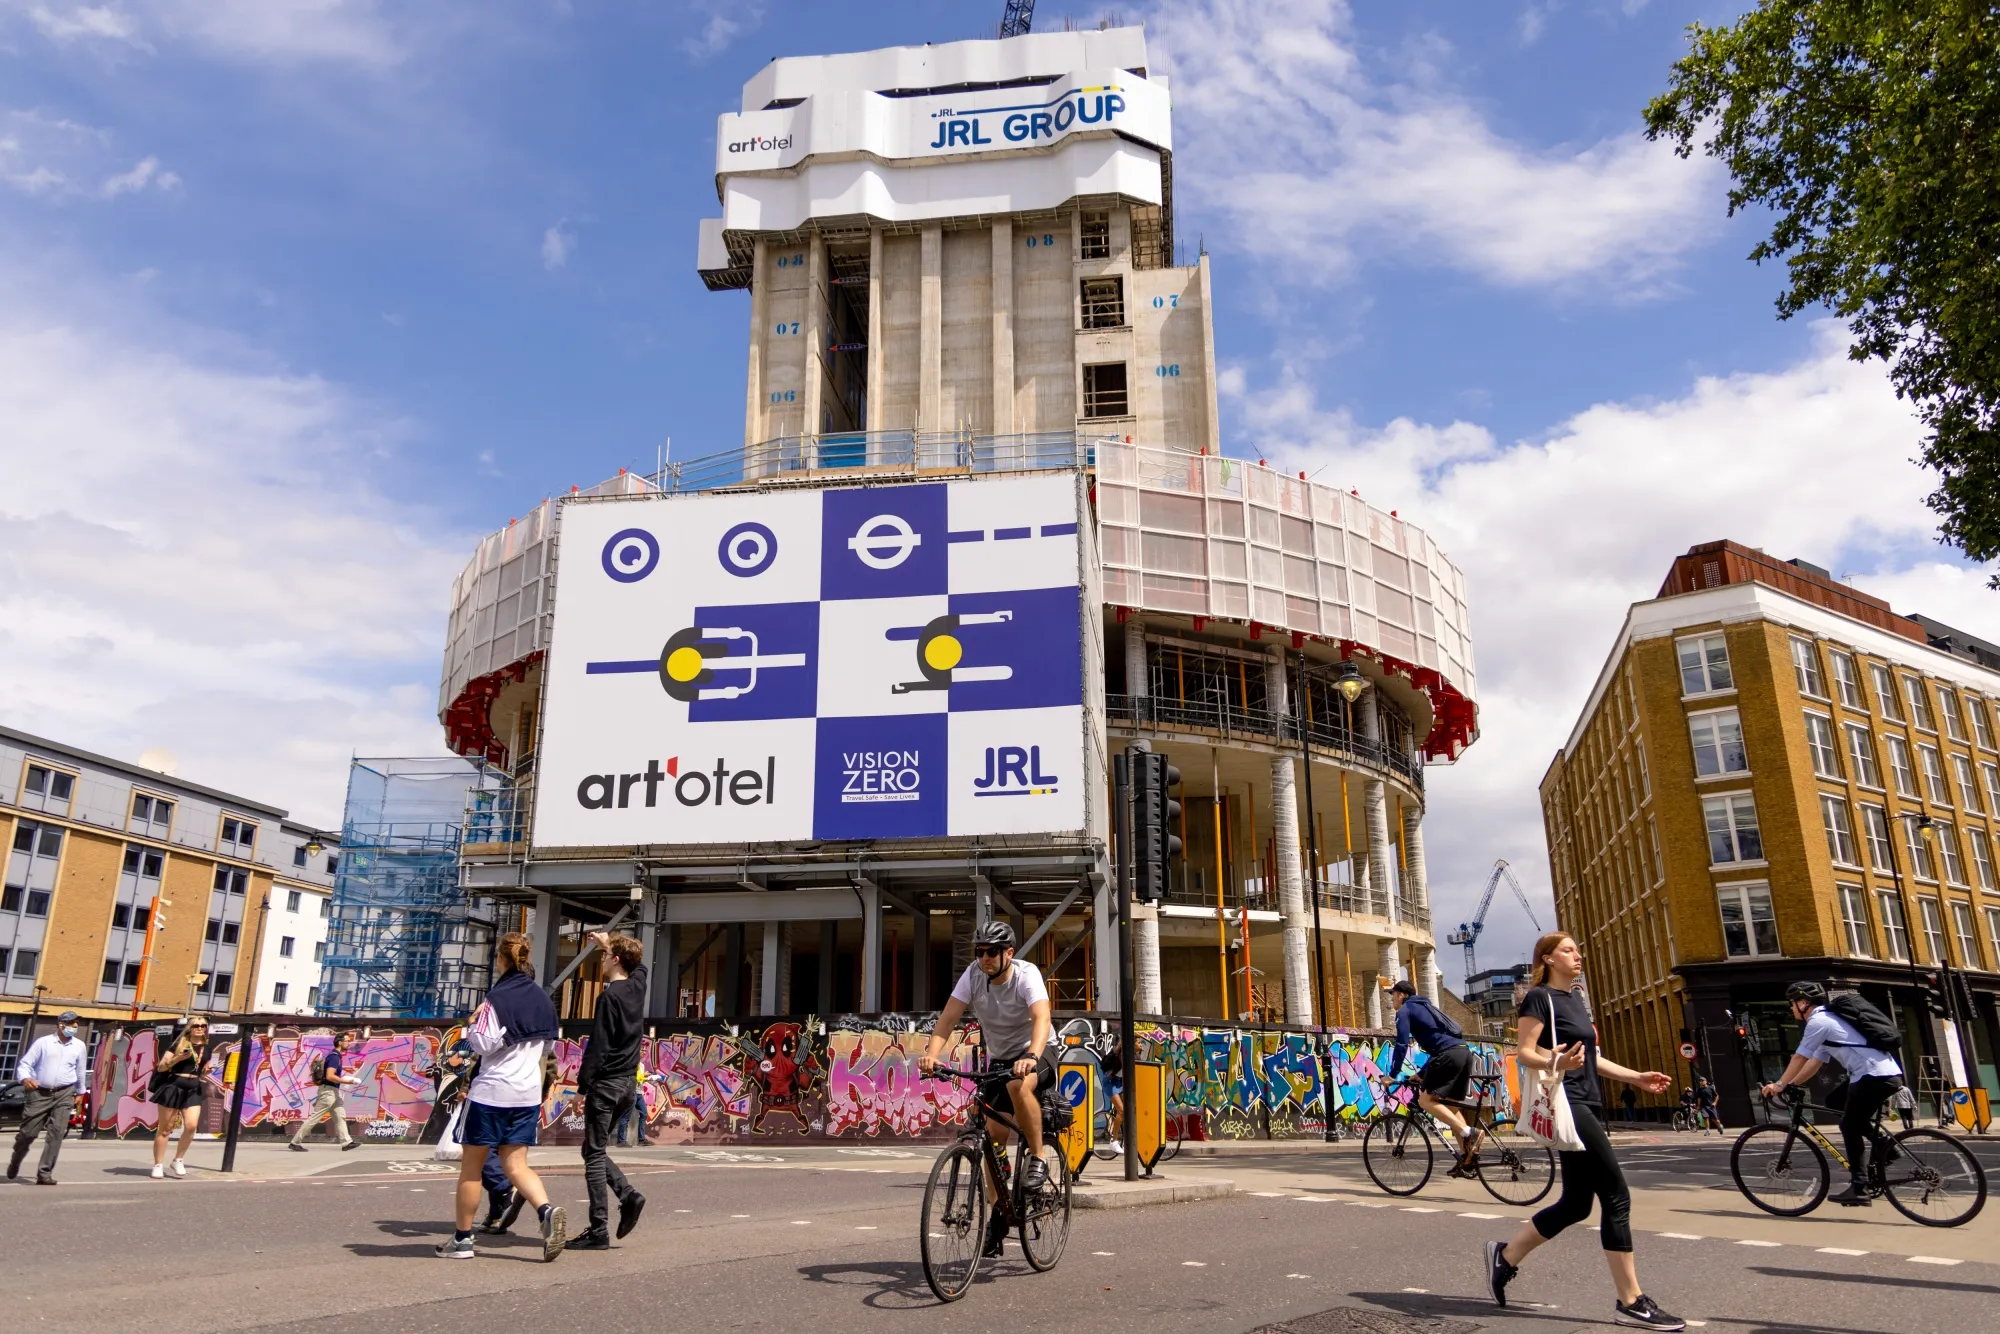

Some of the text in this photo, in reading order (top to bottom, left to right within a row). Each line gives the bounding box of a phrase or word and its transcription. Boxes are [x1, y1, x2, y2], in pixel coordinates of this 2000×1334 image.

[931, 94, 1126, 149] JRL GROUP
[937, 109, 956, 118] JRL
[842, 750, 919, 769] VISION
[974, 745, 1059, 788] JRL
[577, 756, 776, 810] art'otel
[842, 768, 920, 793] ZERO
